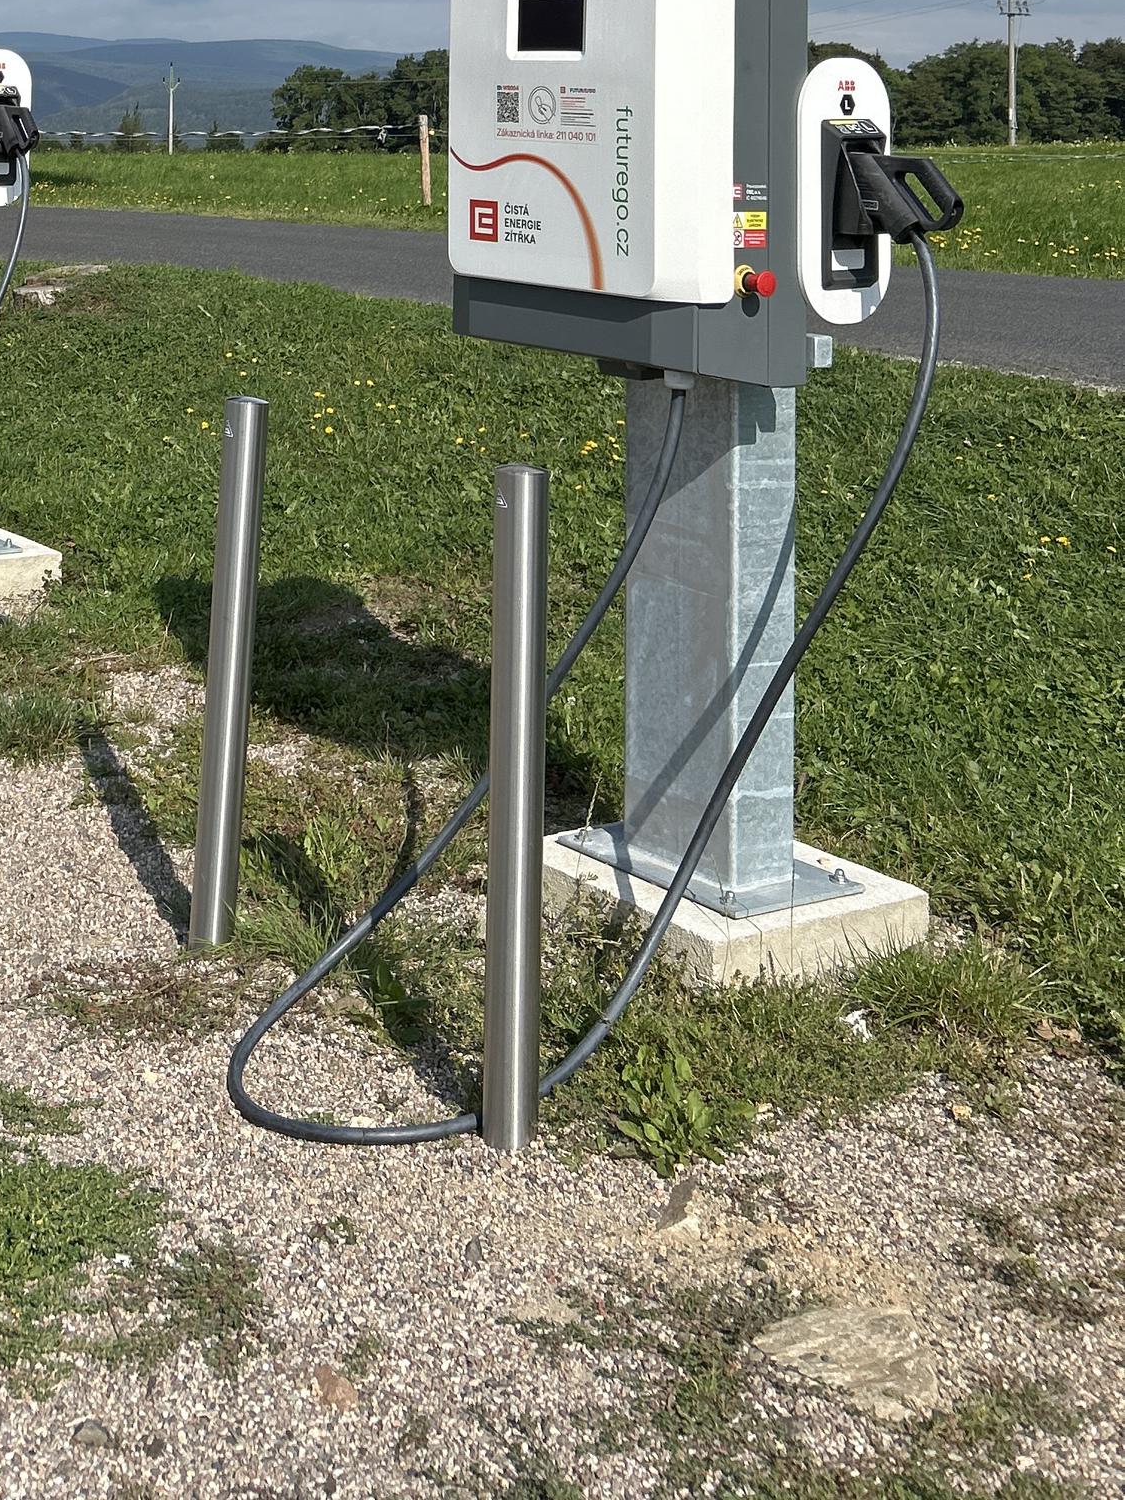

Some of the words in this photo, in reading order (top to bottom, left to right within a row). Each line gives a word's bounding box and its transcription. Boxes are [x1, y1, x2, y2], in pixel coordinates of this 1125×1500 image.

[838, 80, 855, 91] ABB
[556, 131, 567, 141] 211
[568, 132, 584, 141] 040
[612, 105, 633, 257] futurego.cz
[504, 202, 530, 216] ČISTÁ
[504, 218, 542, 231] ENERGIE
[504, 231, 536, 244] ZÍTŘKA
